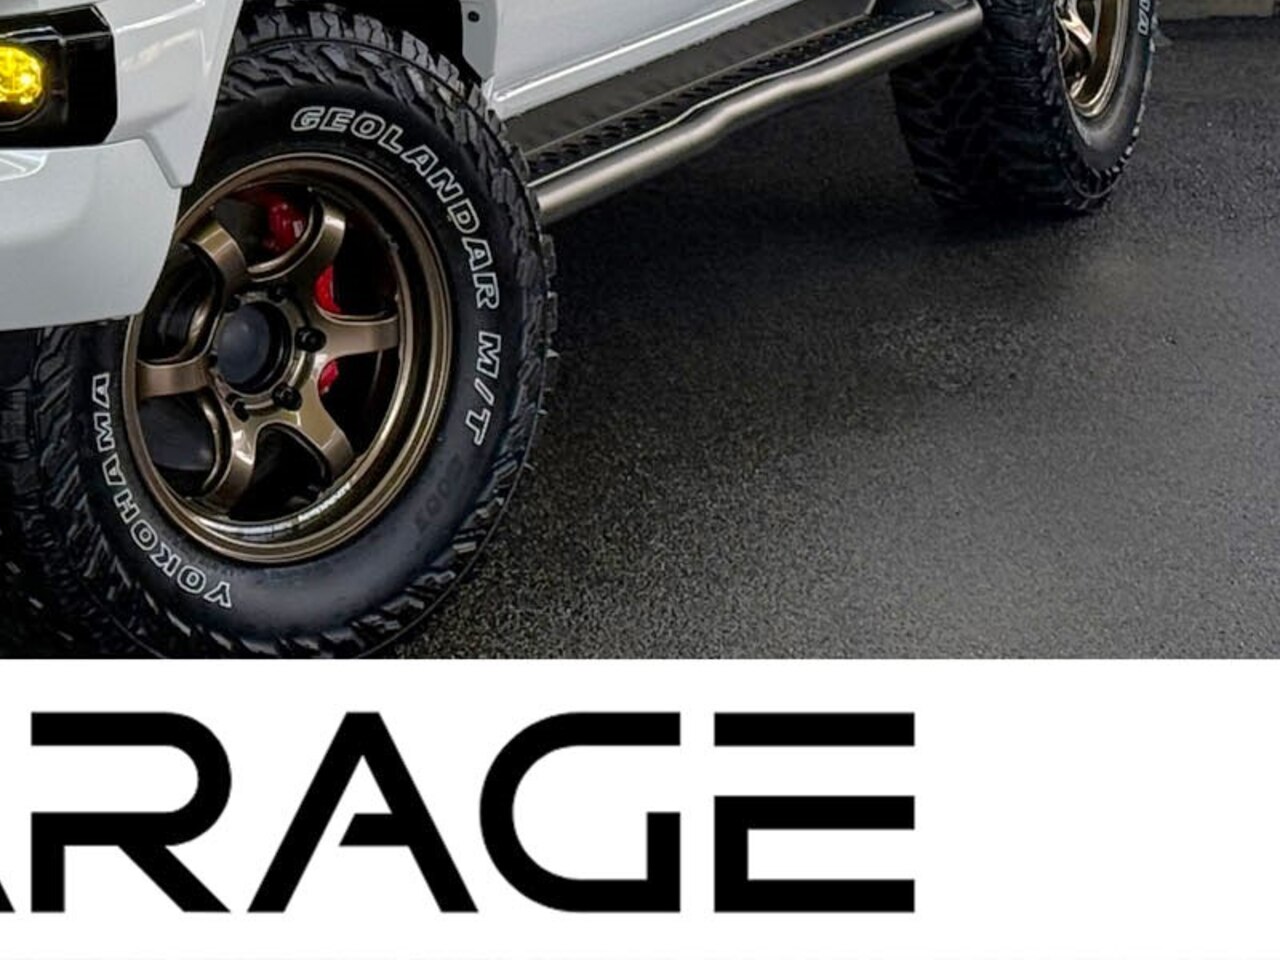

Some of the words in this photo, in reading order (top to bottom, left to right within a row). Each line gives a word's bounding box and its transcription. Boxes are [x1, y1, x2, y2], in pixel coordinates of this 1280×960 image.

[291, 106, 499, 309] GEOLANDAR
[465, 331, 502, 446] M/T
[92, 372, 232, 608] YOKOHAMA
